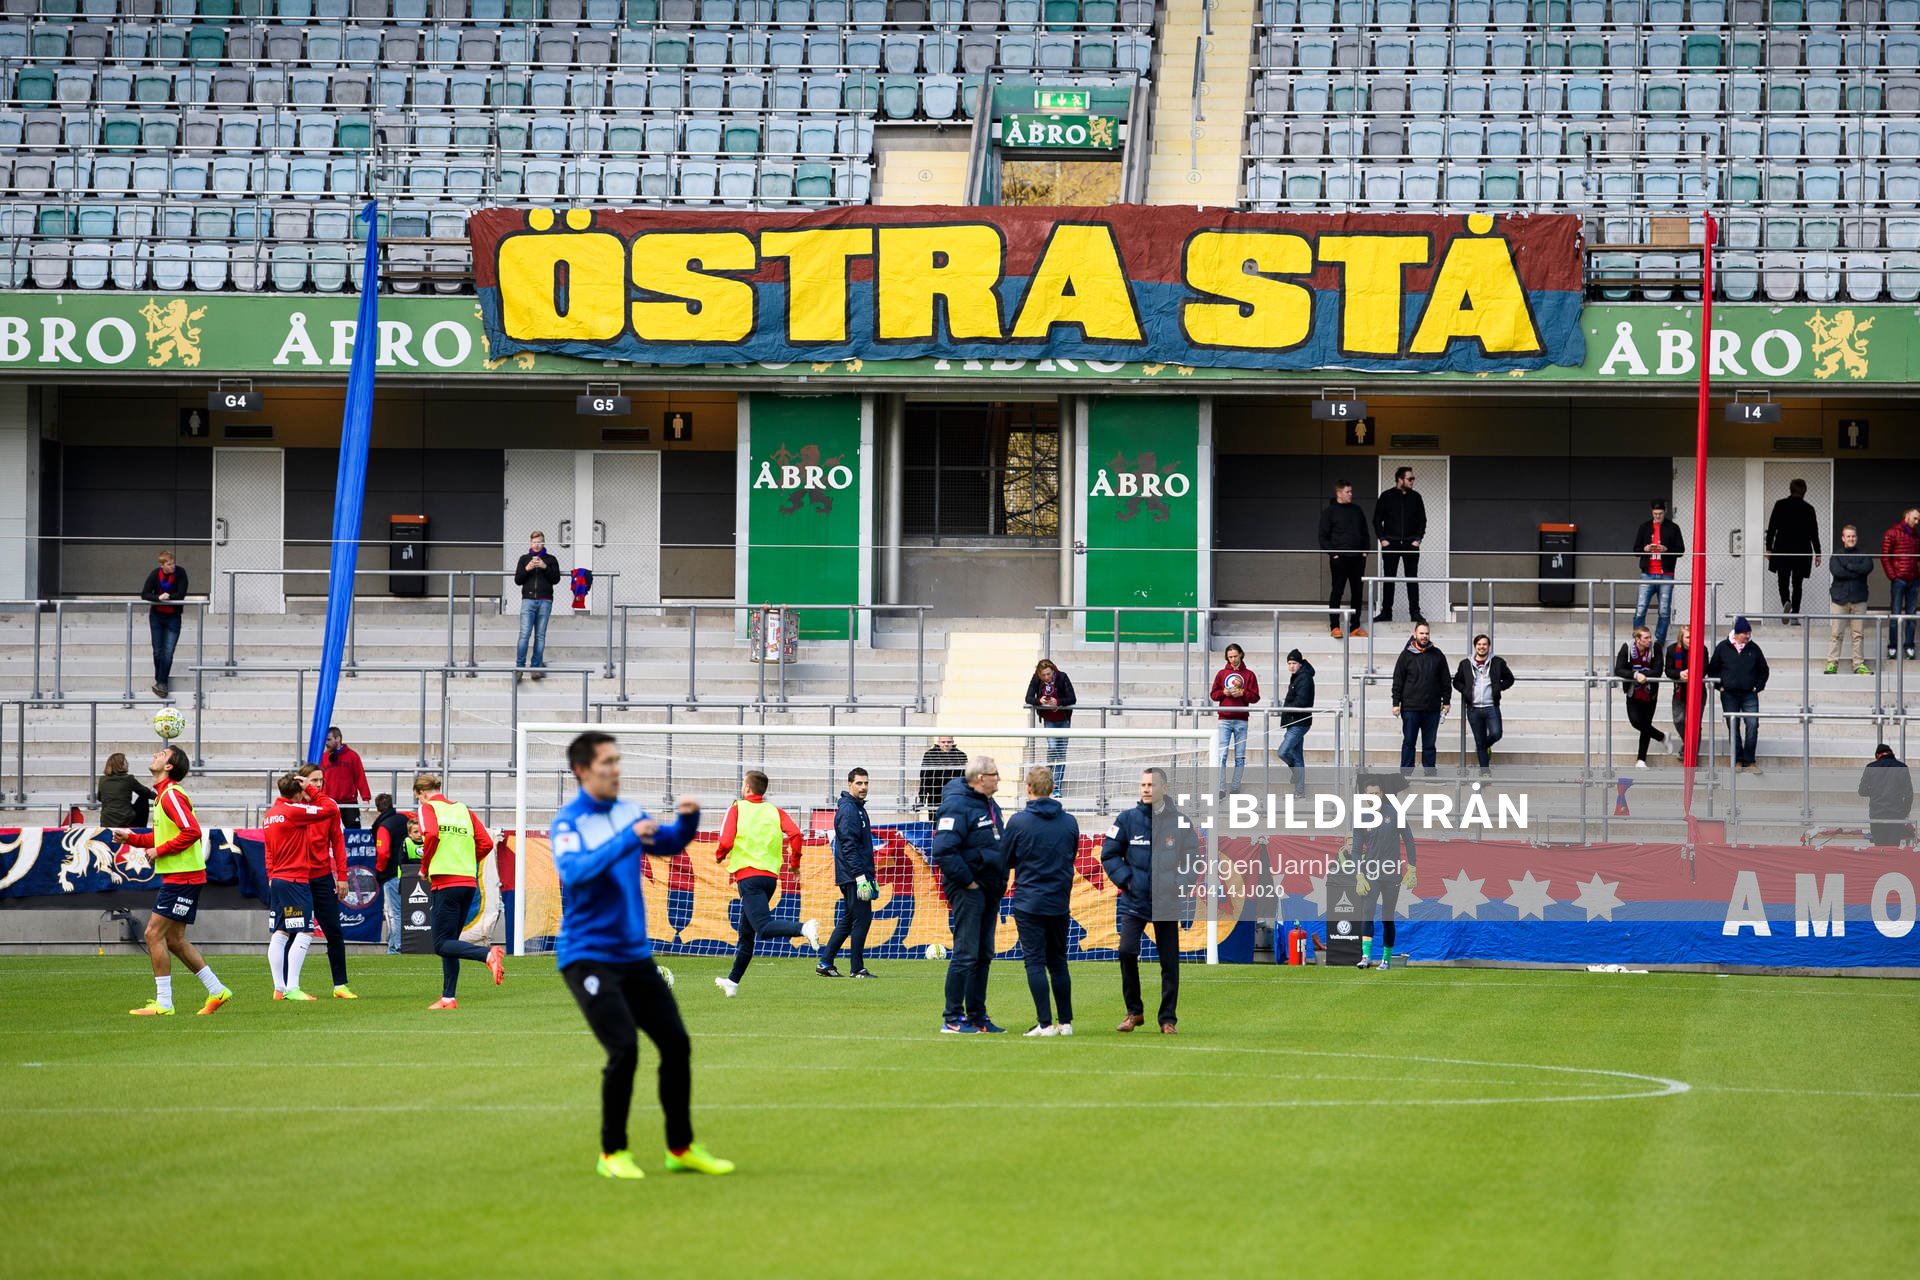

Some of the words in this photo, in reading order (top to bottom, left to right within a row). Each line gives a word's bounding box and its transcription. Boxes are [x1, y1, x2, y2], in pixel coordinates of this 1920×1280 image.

[1005, 120, 1087, 145] ÅBRO
[496, 208, 1145, 343] ÖSTRA
[1181, 213, 1542, 355] STÅ
[1598, 321, 1802, 377] ÅBRO
[225, 394, 247, 408] G4
[593, 398, 614, 411] G5
[753, 461, 853, 490] ÅBRO
[1089, 469, 1190, 497] ÅBRO
